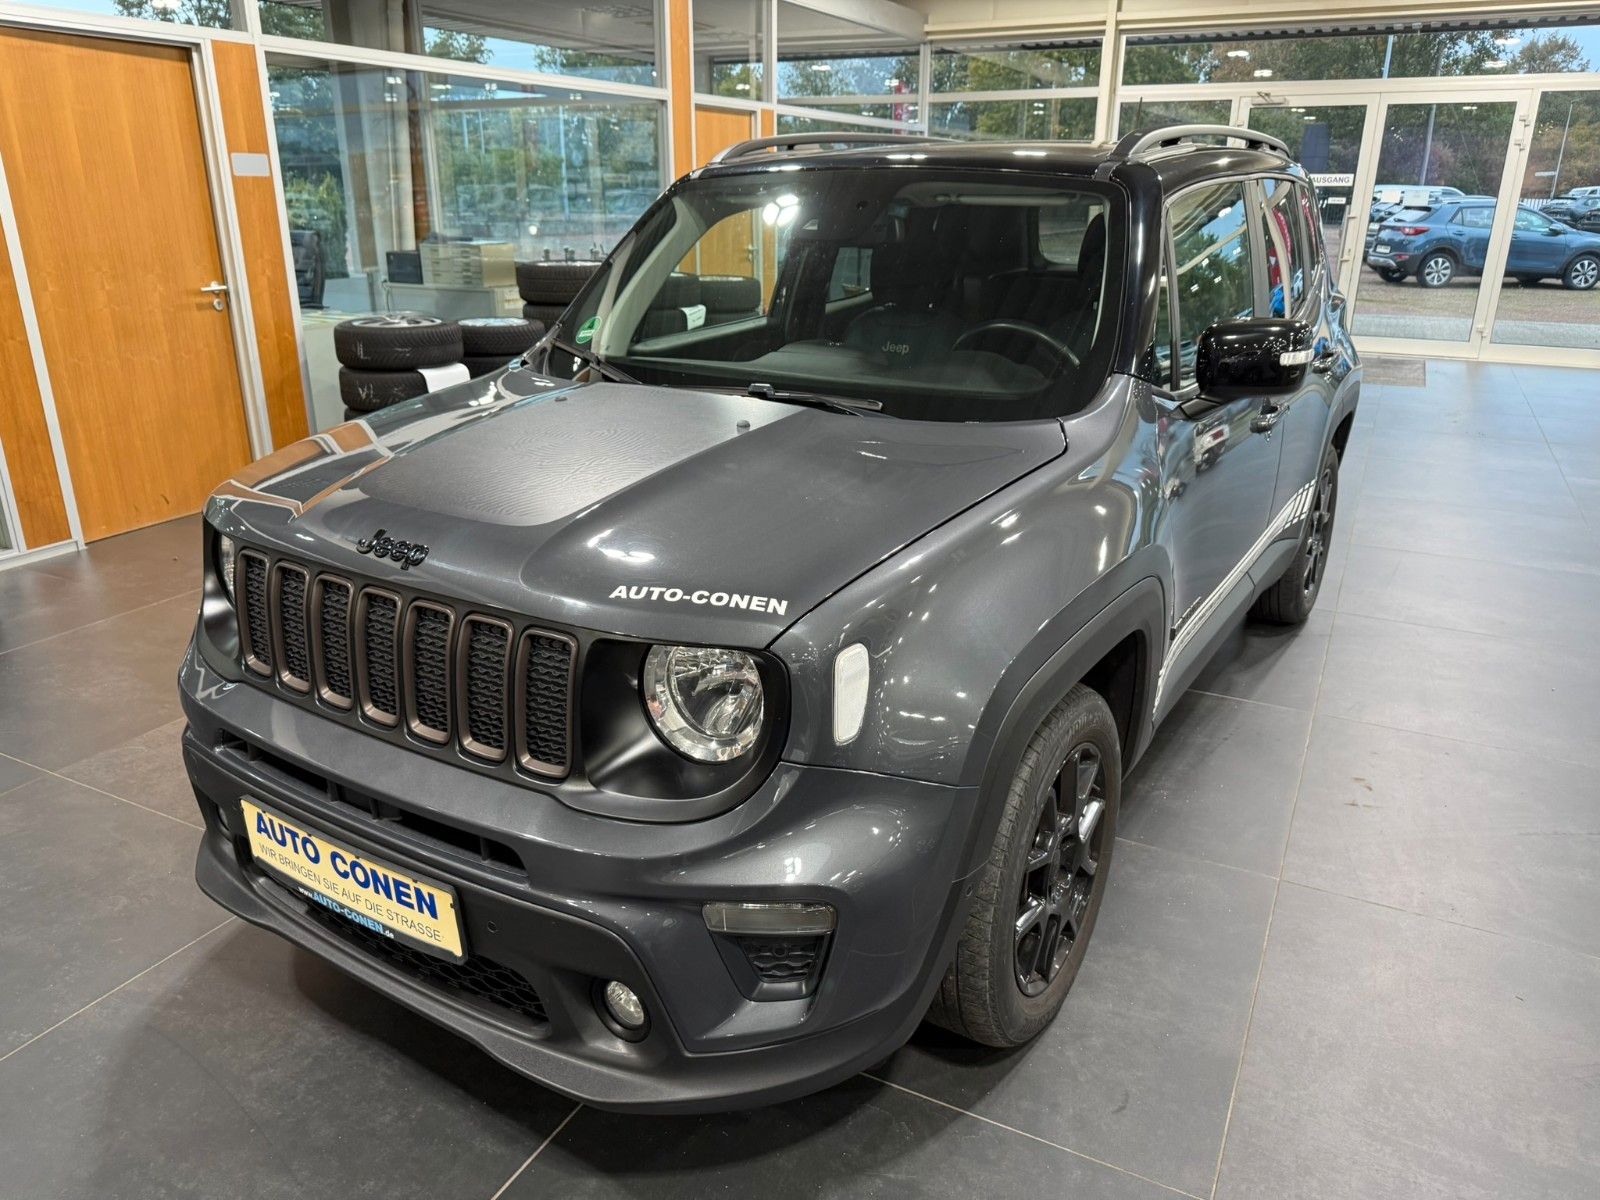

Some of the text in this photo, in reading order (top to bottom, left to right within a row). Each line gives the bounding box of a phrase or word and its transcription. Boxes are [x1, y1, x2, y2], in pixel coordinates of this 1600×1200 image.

[1312, 176, 1350, 184] AUSGANG
[881, 341, 910, 355] Jeep
[356, 528, 430, 571] Jeep
[608, 585, 788, 616] AUTO-CONEN
[256, 811, 439, 921] AUTO CONEN
[259, 842, 443, 943] WIR BRINGEN SIE AUF DIE STRASSE
[297, 886, 395, 939] www.AUTO-CONEN.de
